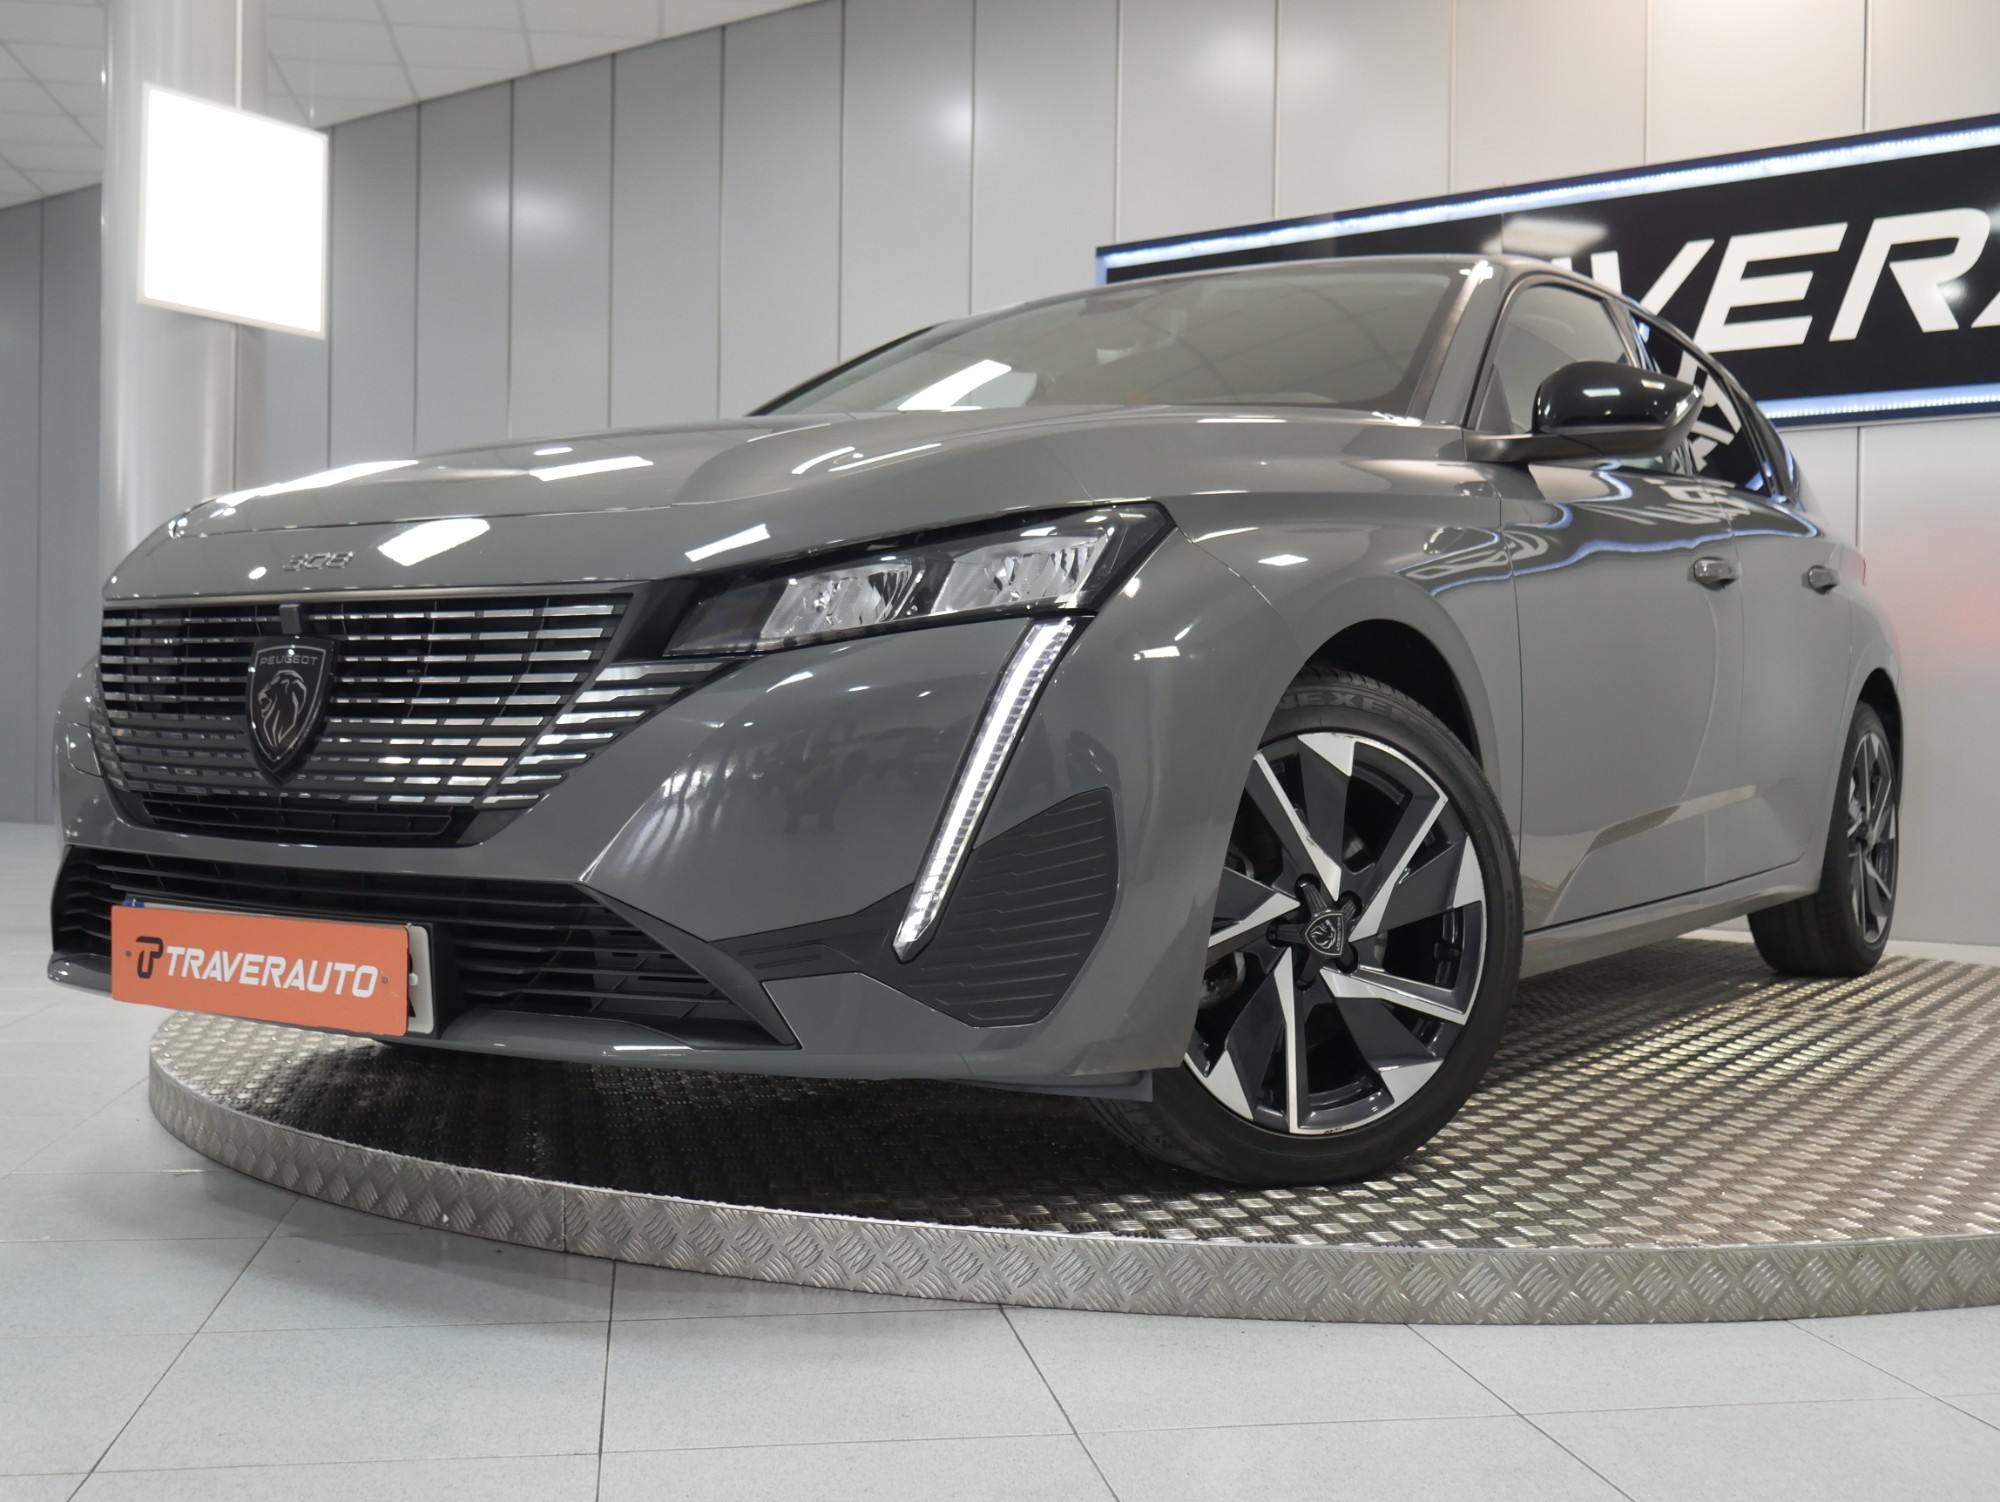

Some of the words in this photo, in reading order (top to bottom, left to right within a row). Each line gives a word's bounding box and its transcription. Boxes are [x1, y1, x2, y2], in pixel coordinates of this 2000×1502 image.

[1552, 208, 2000, 352] VER
[281, 551, 354, 571] 308
[260, 655, 318, 666] PEUGEOT
[166, 945, 379, 998] TRAVERAUTO
